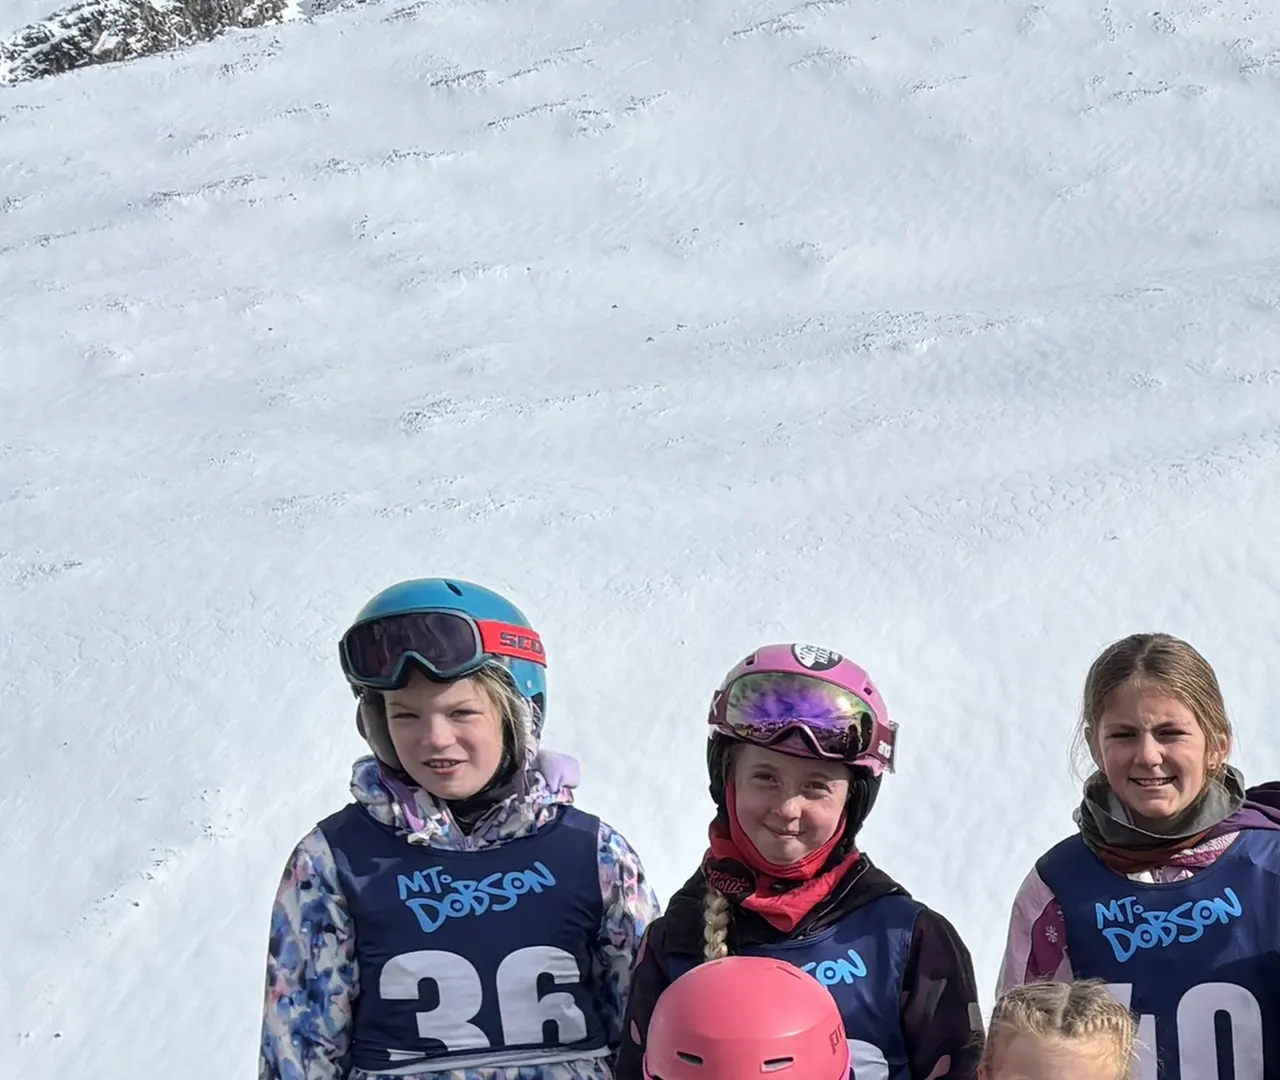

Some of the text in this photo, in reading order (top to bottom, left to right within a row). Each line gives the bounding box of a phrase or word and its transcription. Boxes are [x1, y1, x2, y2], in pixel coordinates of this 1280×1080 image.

[405, 861, 556, 932] DOBSON
[1102, 887, 1243, 963] DOBSON
[379, 946, 587, 1060] 36
